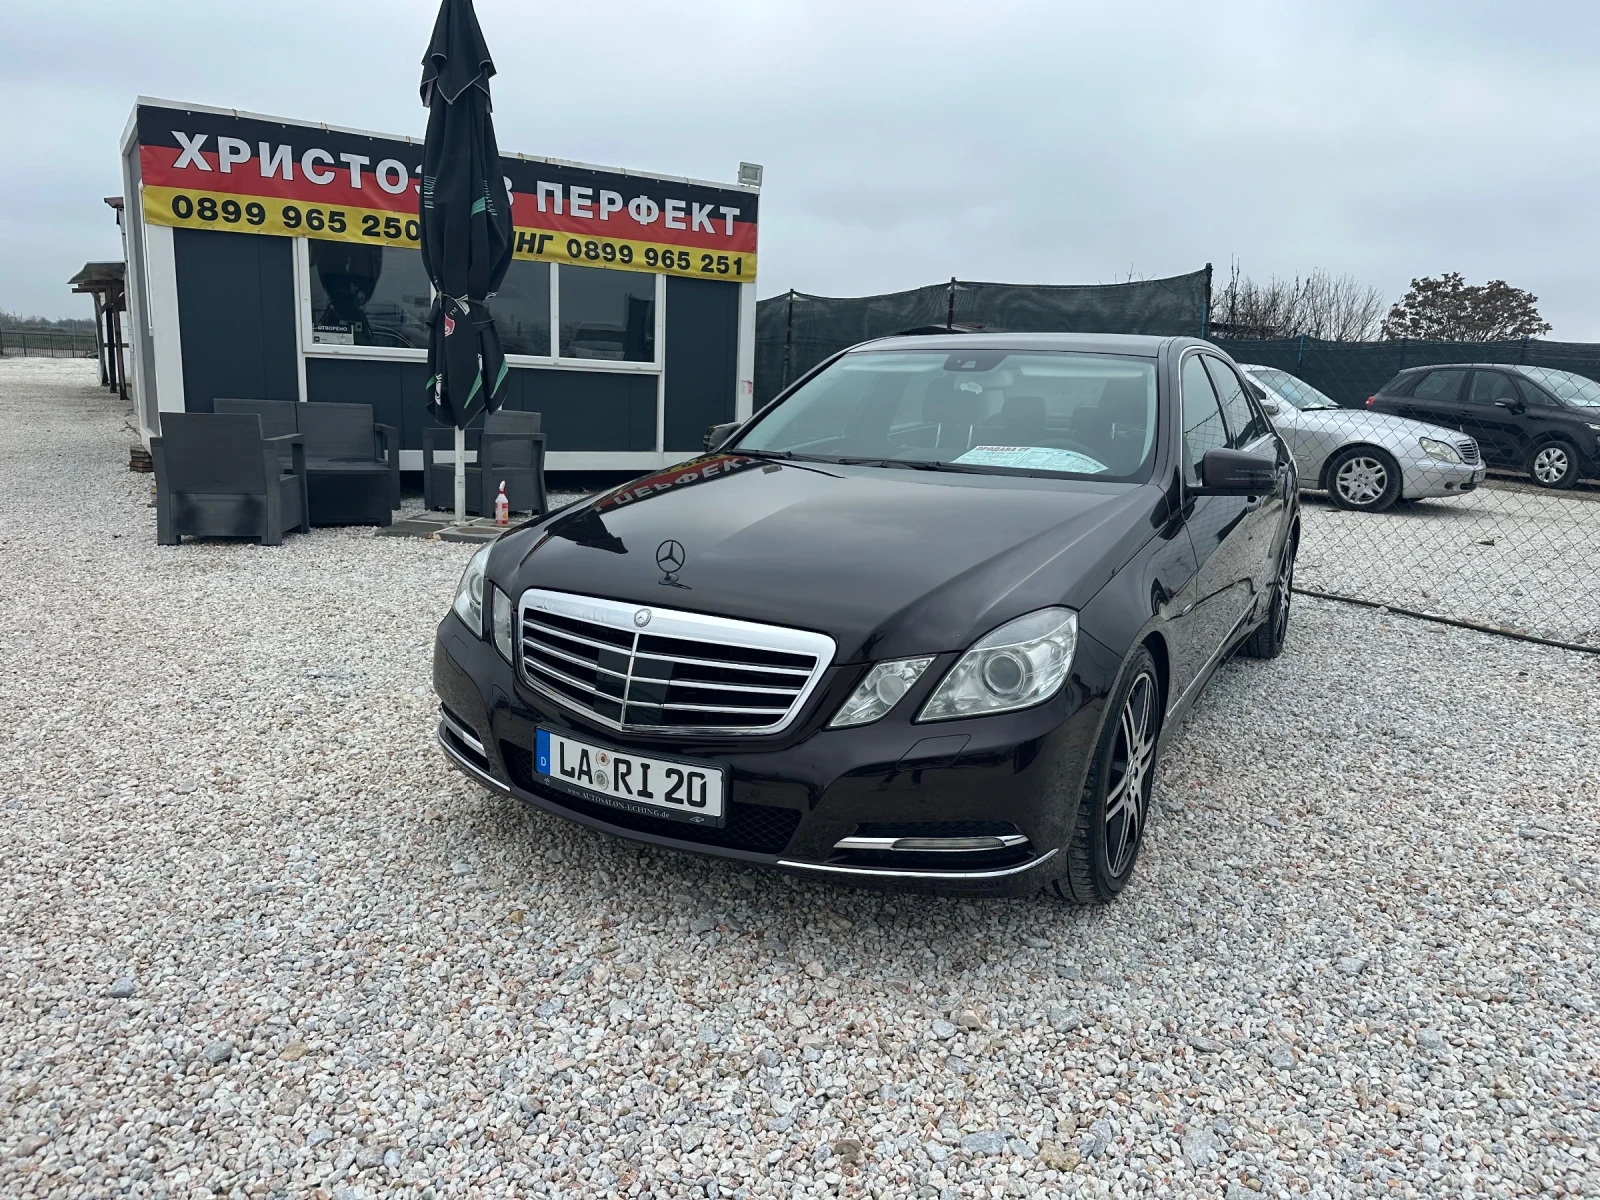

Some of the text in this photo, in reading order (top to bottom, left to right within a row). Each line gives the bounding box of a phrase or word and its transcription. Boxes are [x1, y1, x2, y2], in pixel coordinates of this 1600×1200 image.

[171, 195, 266, 226] 0899
[282, 205, 347, 233] 965
[361, 214, 421, 241] 250
[566, 238, 634, 264] 0899
[645, 247, 691, 271] 965
[701, 254, 743, 276] 251
[536, 180, 741, 236] ПЕРФЕКТ
[540, 756, 547, 767] D
[559, 741, 707, 808] LA RI 20
[567, 788, 671, 818] www.AUTOSALON-ECHING.de
